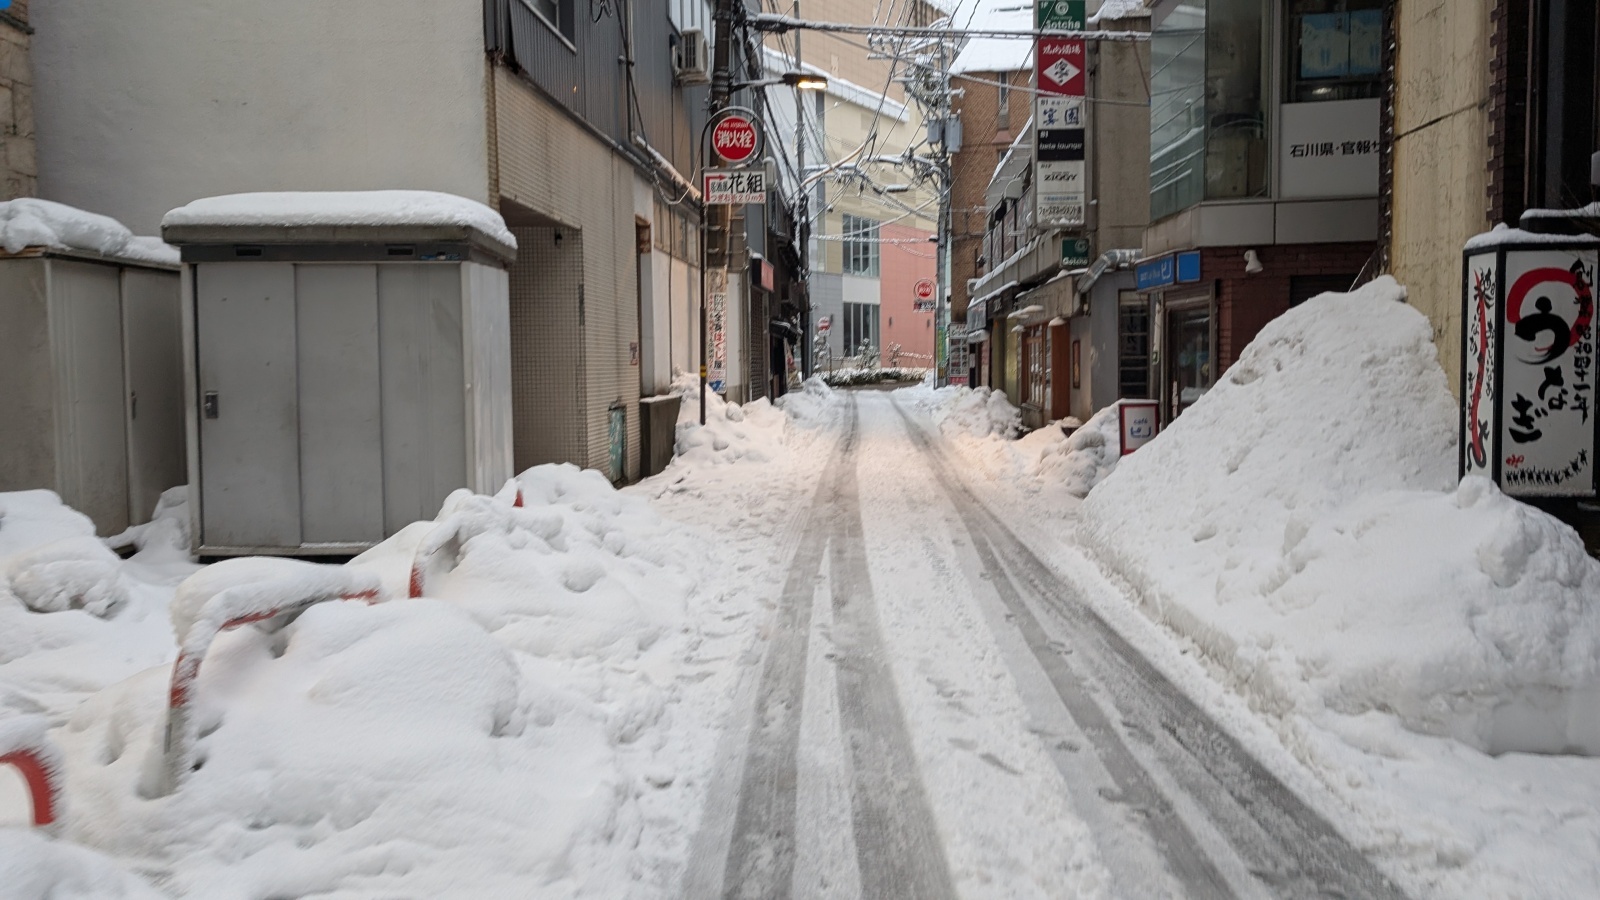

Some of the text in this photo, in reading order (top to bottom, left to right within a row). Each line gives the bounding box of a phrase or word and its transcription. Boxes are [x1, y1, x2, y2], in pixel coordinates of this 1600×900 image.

[717, 129, 753, 148] 消火栓
[728, 172, 765, 194] 花組
